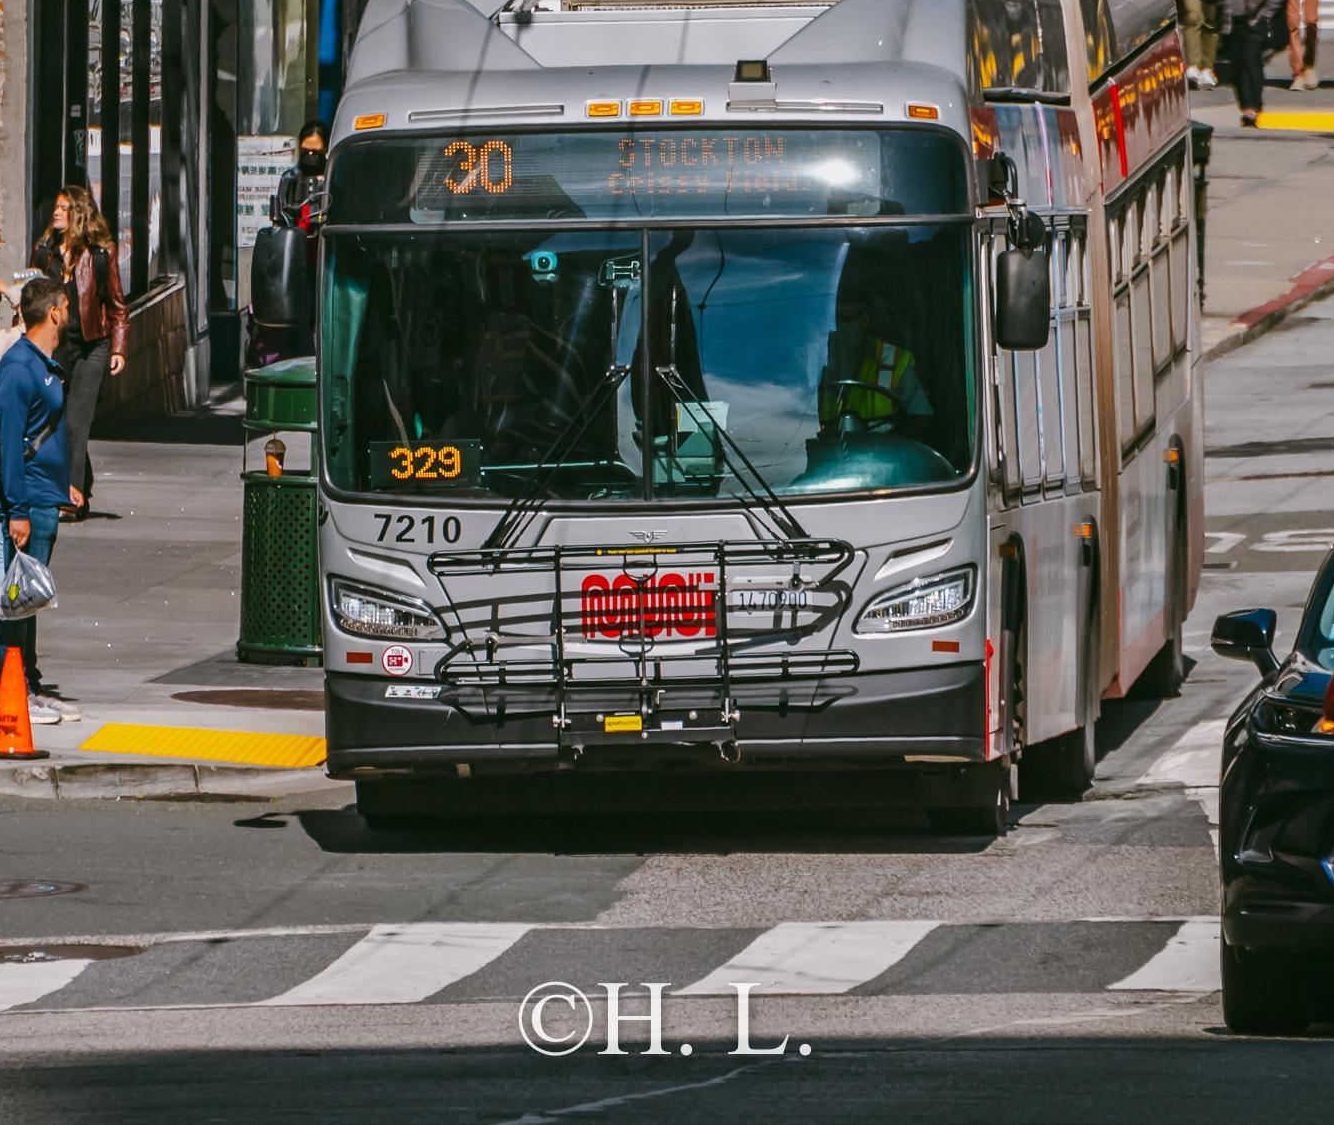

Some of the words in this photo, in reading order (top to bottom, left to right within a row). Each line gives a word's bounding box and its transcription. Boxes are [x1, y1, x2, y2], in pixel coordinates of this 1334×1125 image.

[442, 139, 513, 194] 30
[618, 137, 785, 167] STOCKTON
[390, 446, 461, 479] 329
[373, 513, 462, 544] 7210
